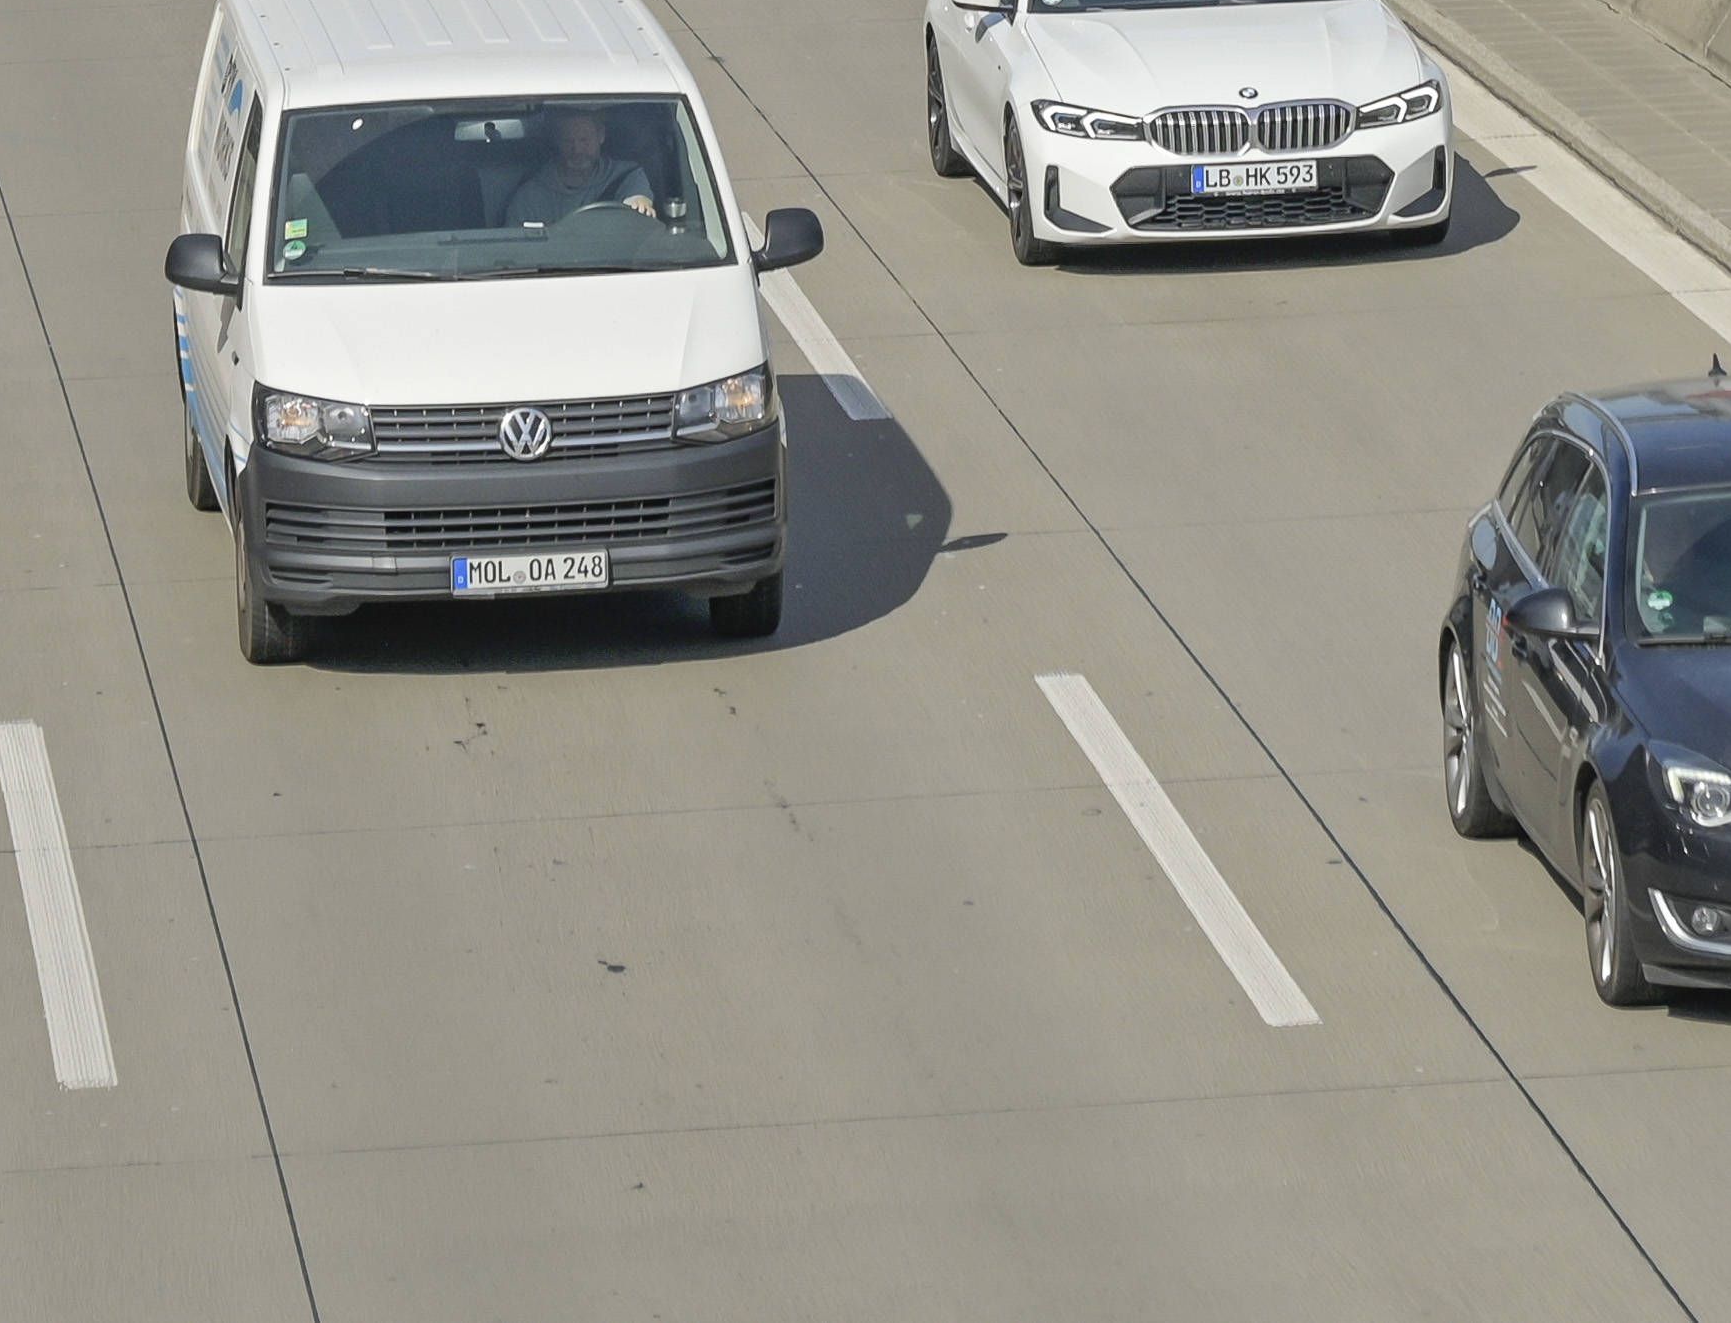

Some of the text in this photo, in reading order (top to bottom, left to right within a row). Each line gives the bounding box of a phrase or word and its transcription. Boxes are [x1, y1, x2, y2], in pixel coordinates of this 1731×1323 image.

[1205, 168, 1232, 188] LB
[1245, 166, 1272, 186] HK
[1276, 164, 1314, 185] 593
[469, 560, 511, 585] MOL
[529, 557, 557, 582] OA
[562, 555, 604, 580] 248
